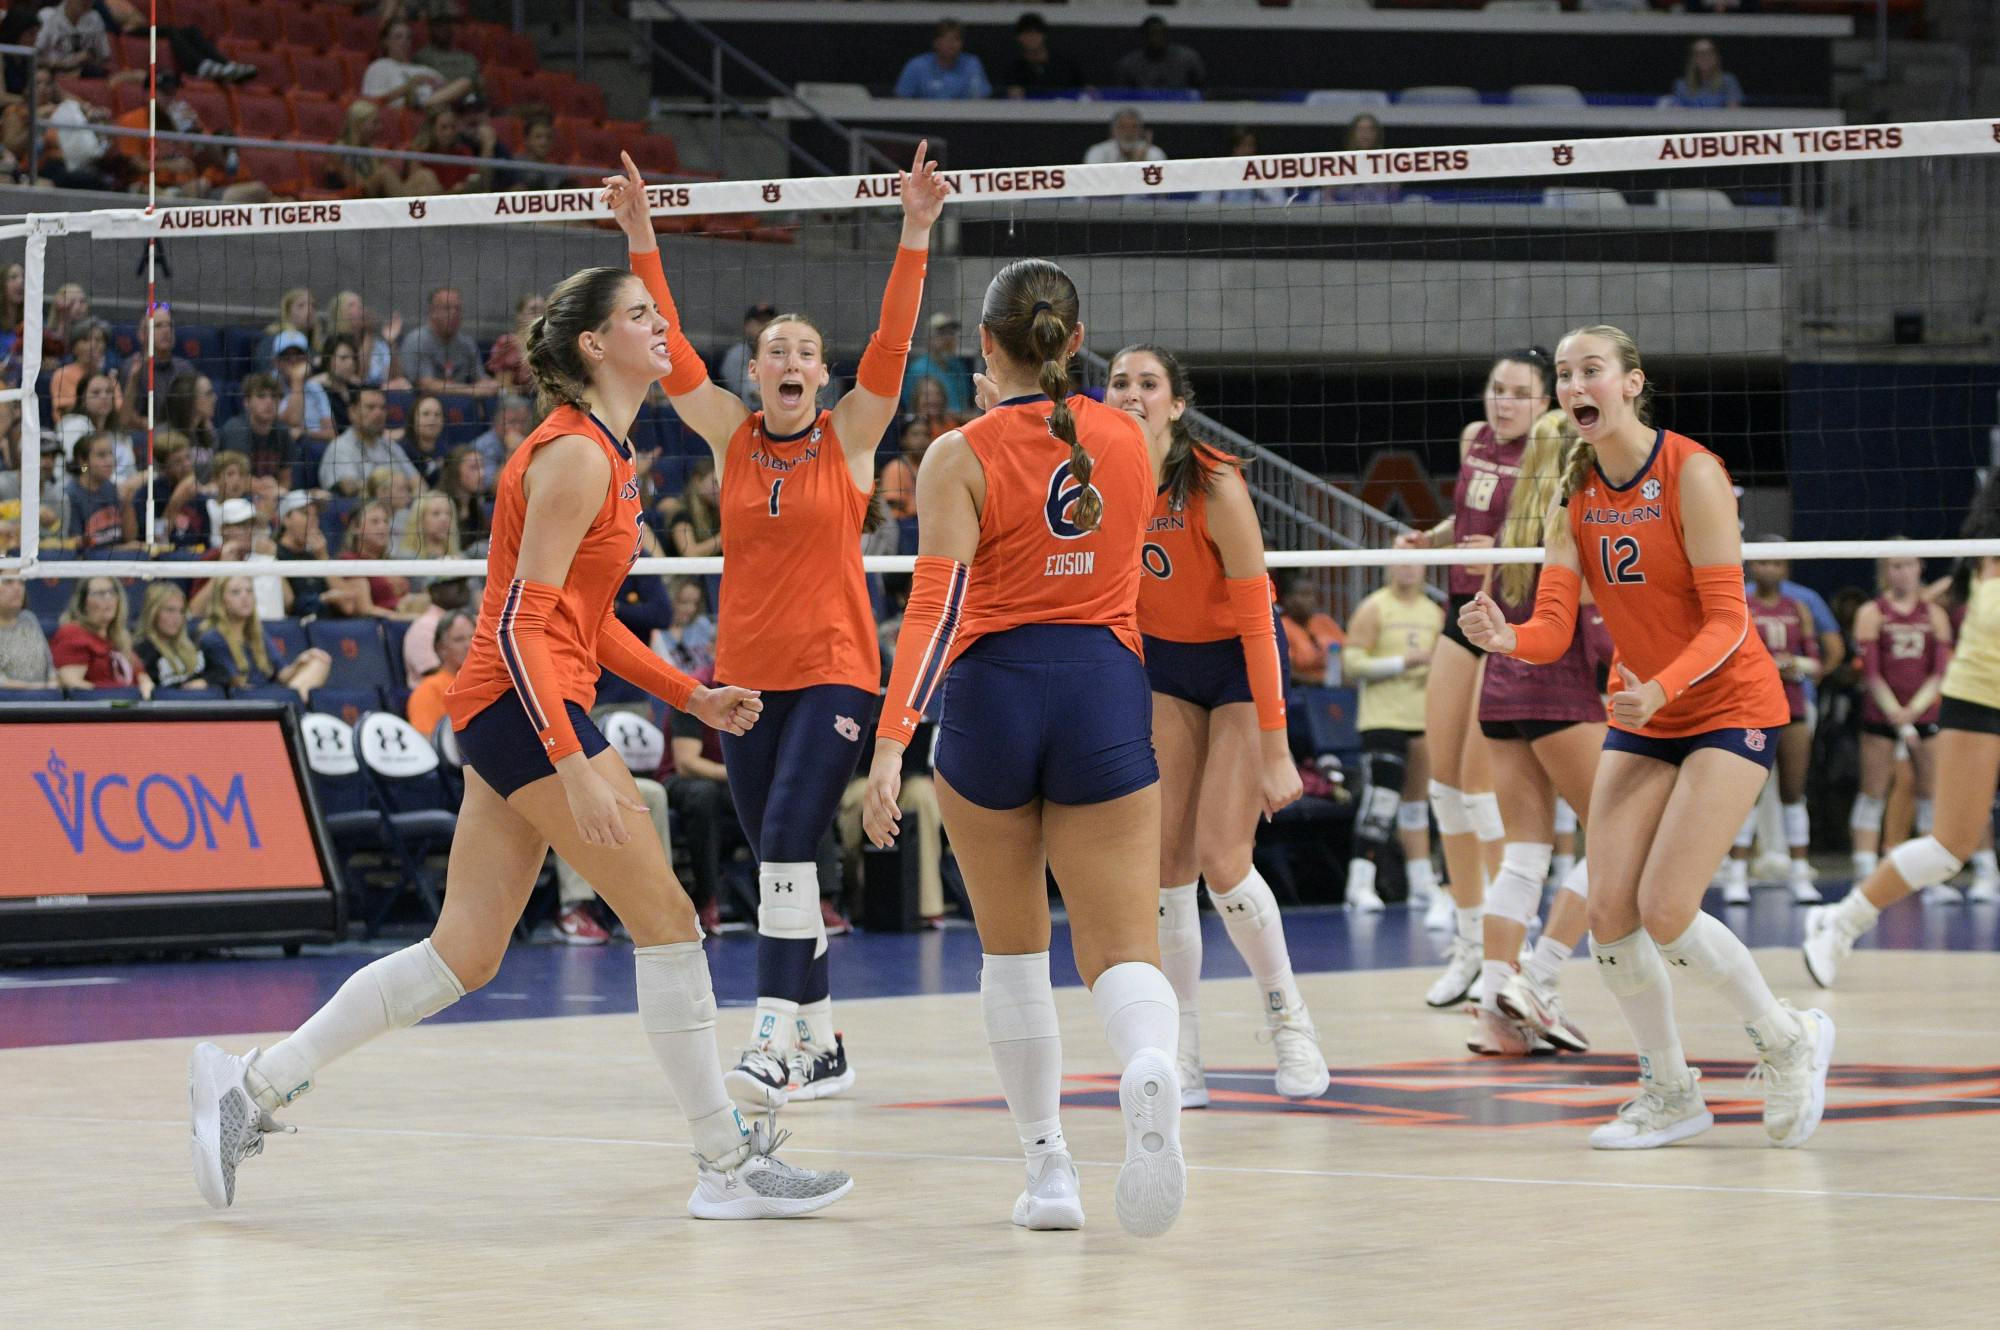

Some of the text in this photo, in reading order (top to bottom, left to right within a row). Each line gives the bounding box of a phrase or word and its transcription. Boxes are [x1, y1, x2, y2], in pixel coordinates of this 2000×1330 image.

[1658, 127, 1903, 160] AUBURN TIGERS
[970, 169, 1066, 193] TIGERS
[1242, 150, 1469, 181] AUBURN TIGERS
[160, 204, 341, 229] AUBURN TIGERS
[495, 191, 594, 215] AUBURN
[768, 478, 784, 517] 1
[1044, 458, 1104, 540] 6
[1146, 515, 1185, 532] URN
[1584, 503, 1663, 525] AUBURN
[1043, 551, 1095, 576] EDSON
[1140, 541, 1173, 580] 0
[1600, 535, 1646, 585] 12
[33, 771, 263, 854] VCOM
